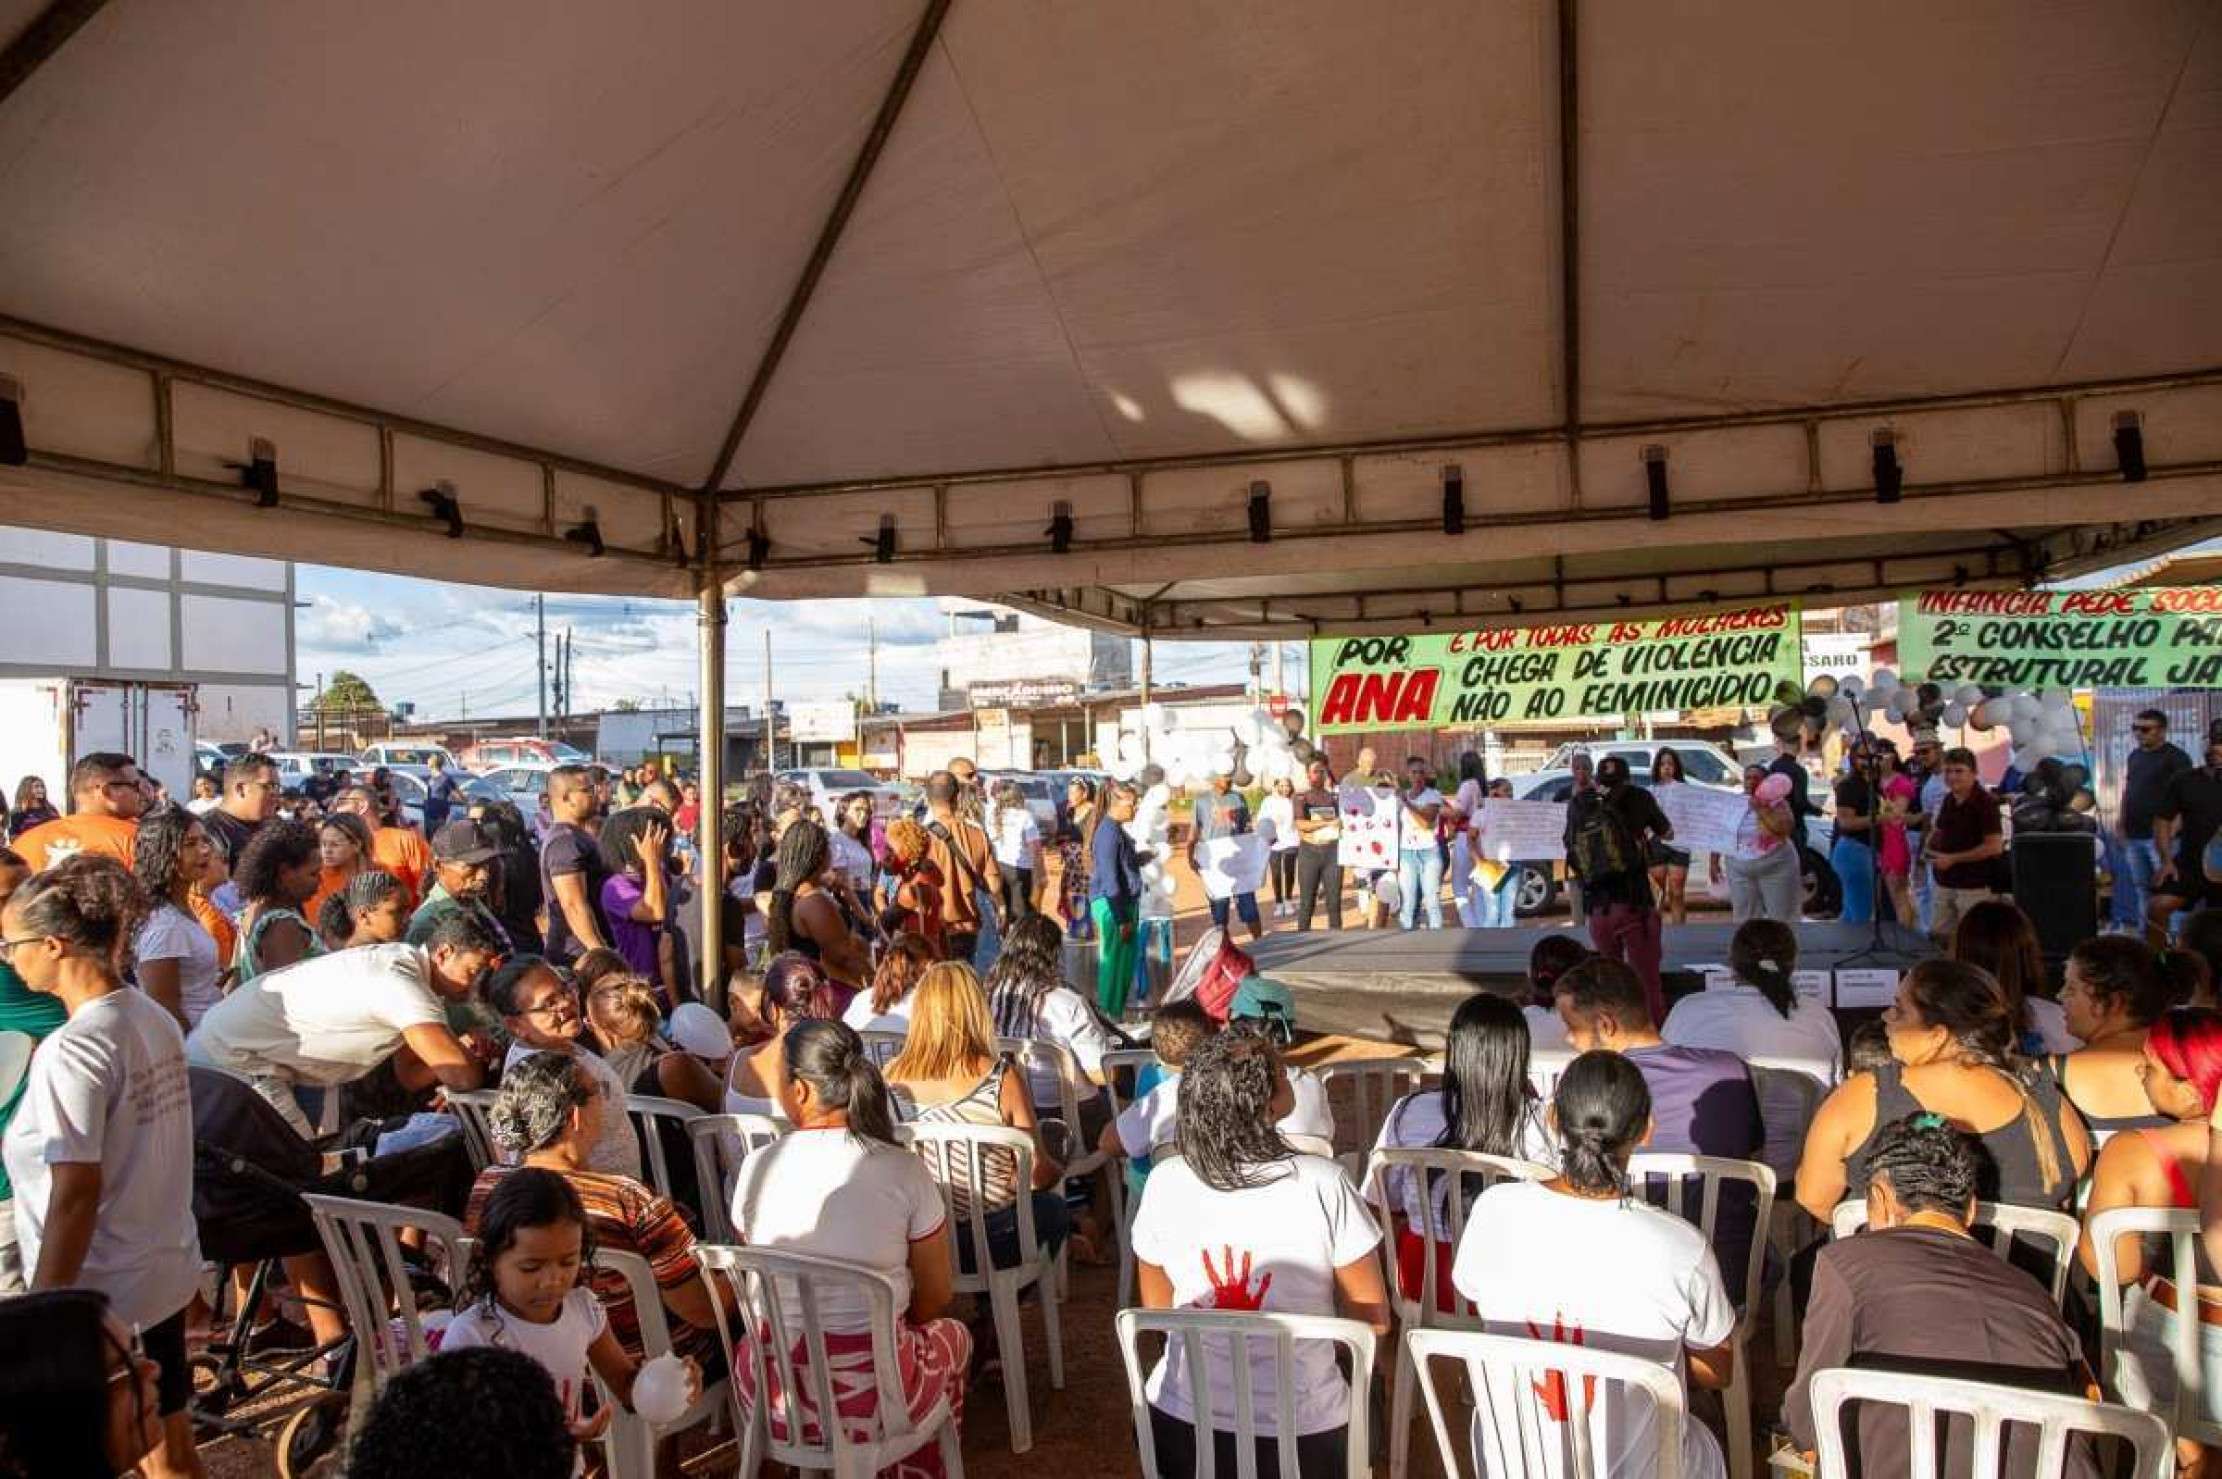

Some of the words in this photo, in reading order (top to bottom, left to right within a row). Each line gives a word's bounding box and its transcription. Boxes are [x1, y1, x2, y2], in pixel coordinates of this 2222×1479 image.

[2061, 590, 2139, 613] PEDE
[1976, 618, 2161, 650] CONSELHO
[1336, 636, 1411, 667] POR
[1461, 652, 1560, 688] CHEGA
[1571, 647, 1612, 680] DE
[1926, 654, 2148, 686] ESTRUTURAL
[1320, 668, 1440, 725] ANA
[1450, 686, 1511, 723] NÃO
[1523, 686, 1566, 719] AO
